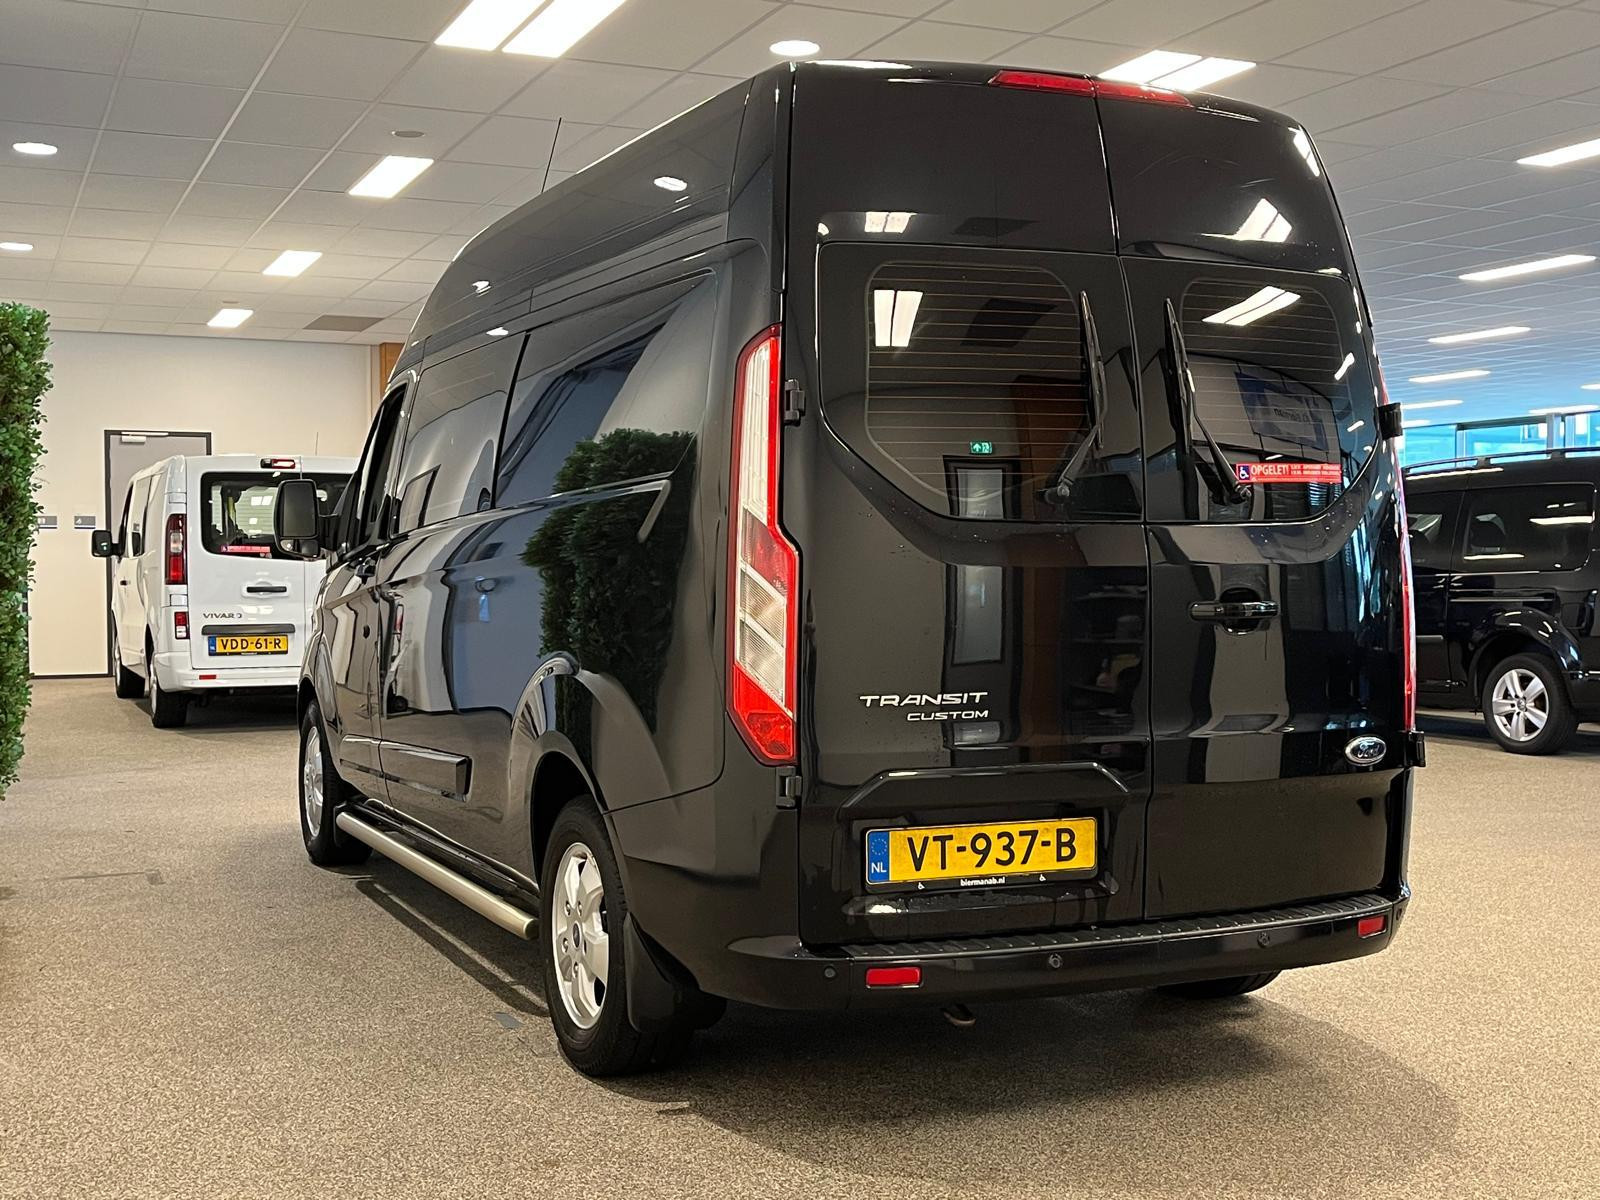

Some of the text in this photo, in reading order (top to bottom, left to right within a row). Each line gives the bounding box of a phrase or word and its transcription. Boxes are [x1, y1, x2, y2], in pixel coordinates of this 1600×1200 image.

[1251, 464, 1289, 475] OPGELET!
[220, 637, 282, 651] VDD-61-R
[860, 691, 988, 707] TRANSIT
[907, 710, 989, 721] CUSTOM
[1357, 740, 1381, 758] Ford
[907, 827, 1077, 873] VT-937-B
[871, 862, 887, 874] NL
[960, 876, 1006, 888] biermanab.nl
